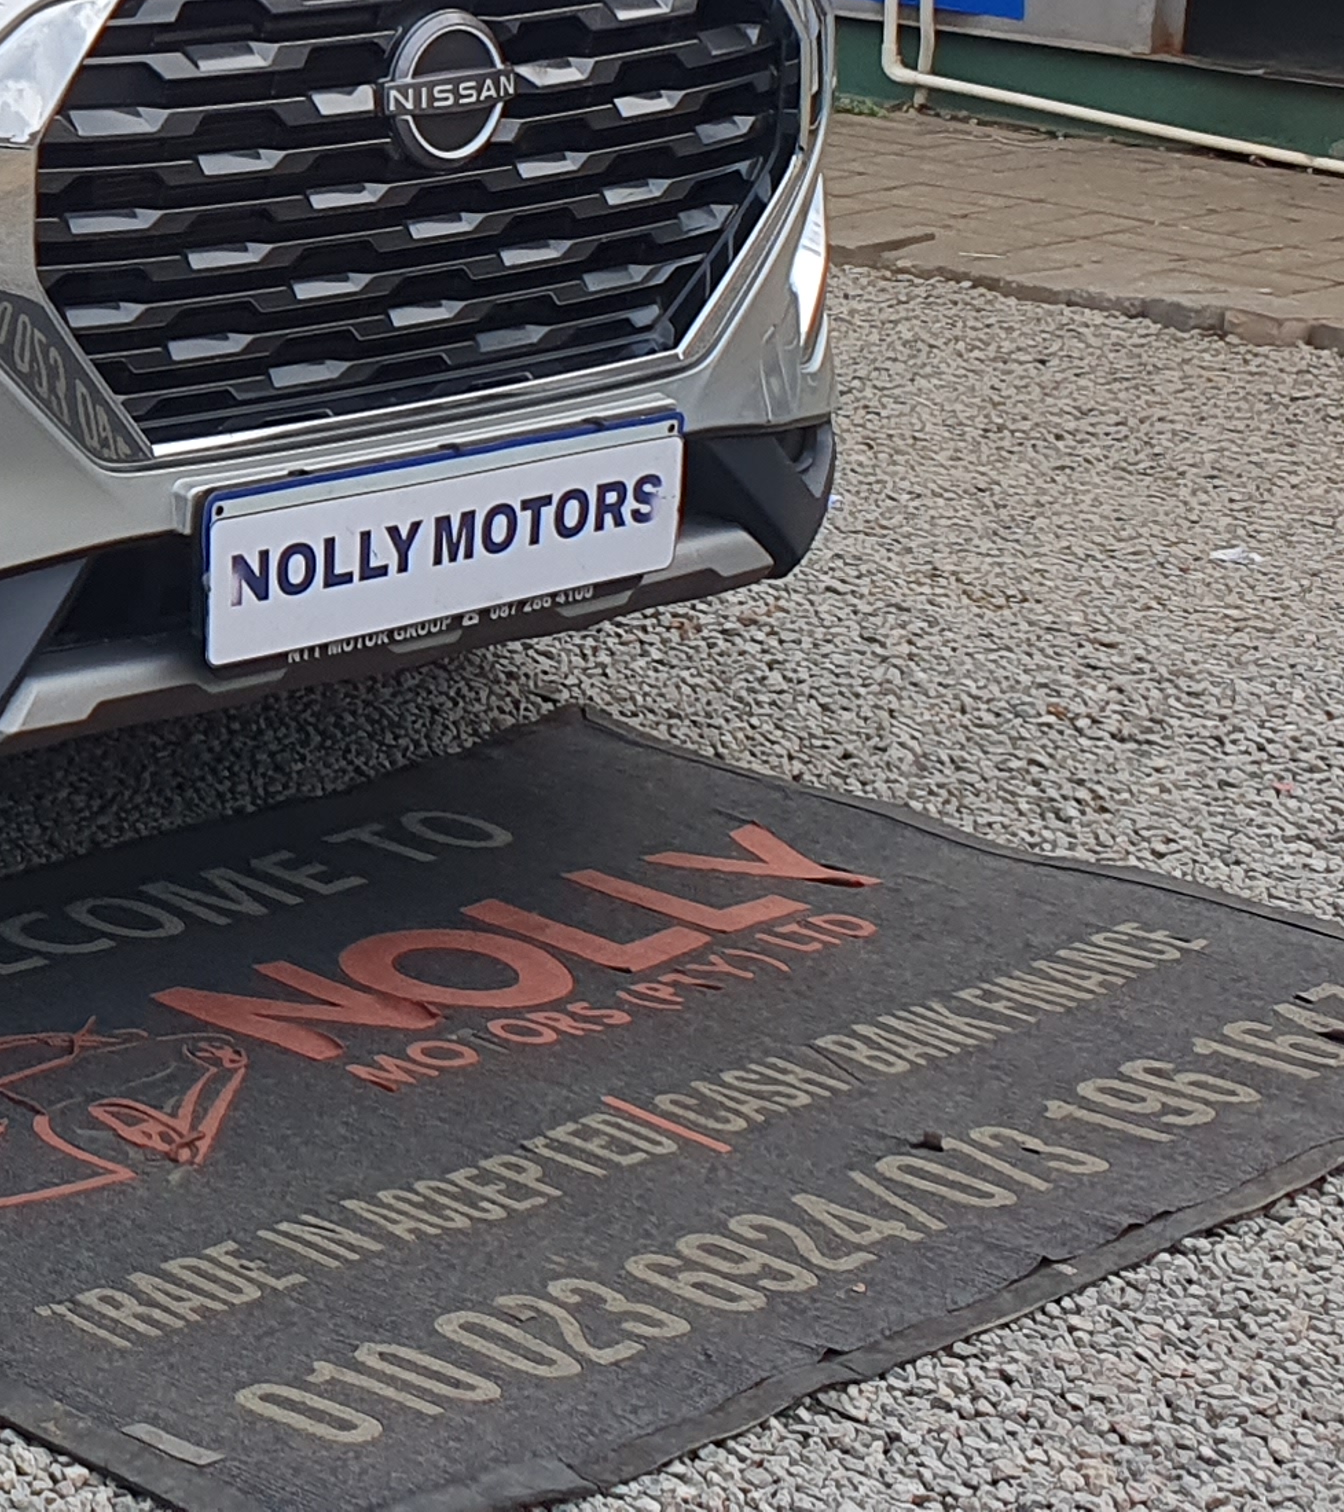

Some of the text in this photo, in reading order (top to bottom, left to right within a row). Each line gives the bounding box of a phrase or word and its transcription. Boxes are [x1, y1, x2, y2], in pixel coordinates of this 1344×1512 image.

[389, 73, 515, 111] NISSAN
[230, 473, 662, 607] NOLLY MOTORS
[324, 810, 512, 862] TO
[151, 821, 882, 1060] NOLLY
[345, 913, 878, 1092] MOTORS (PTY) LTD
[34, 1240, 308, 1349] TRADE
[255, 1214, 384, 1268] IN
[958, 922, 1212, 1024] FINANCE
[234, 1342, 502, 1444] 010
[434, 1277, 694, 1378] 023
[1044, 1058, 1263, 1144] 196
[1191, 982, 1344, 1080] 164
